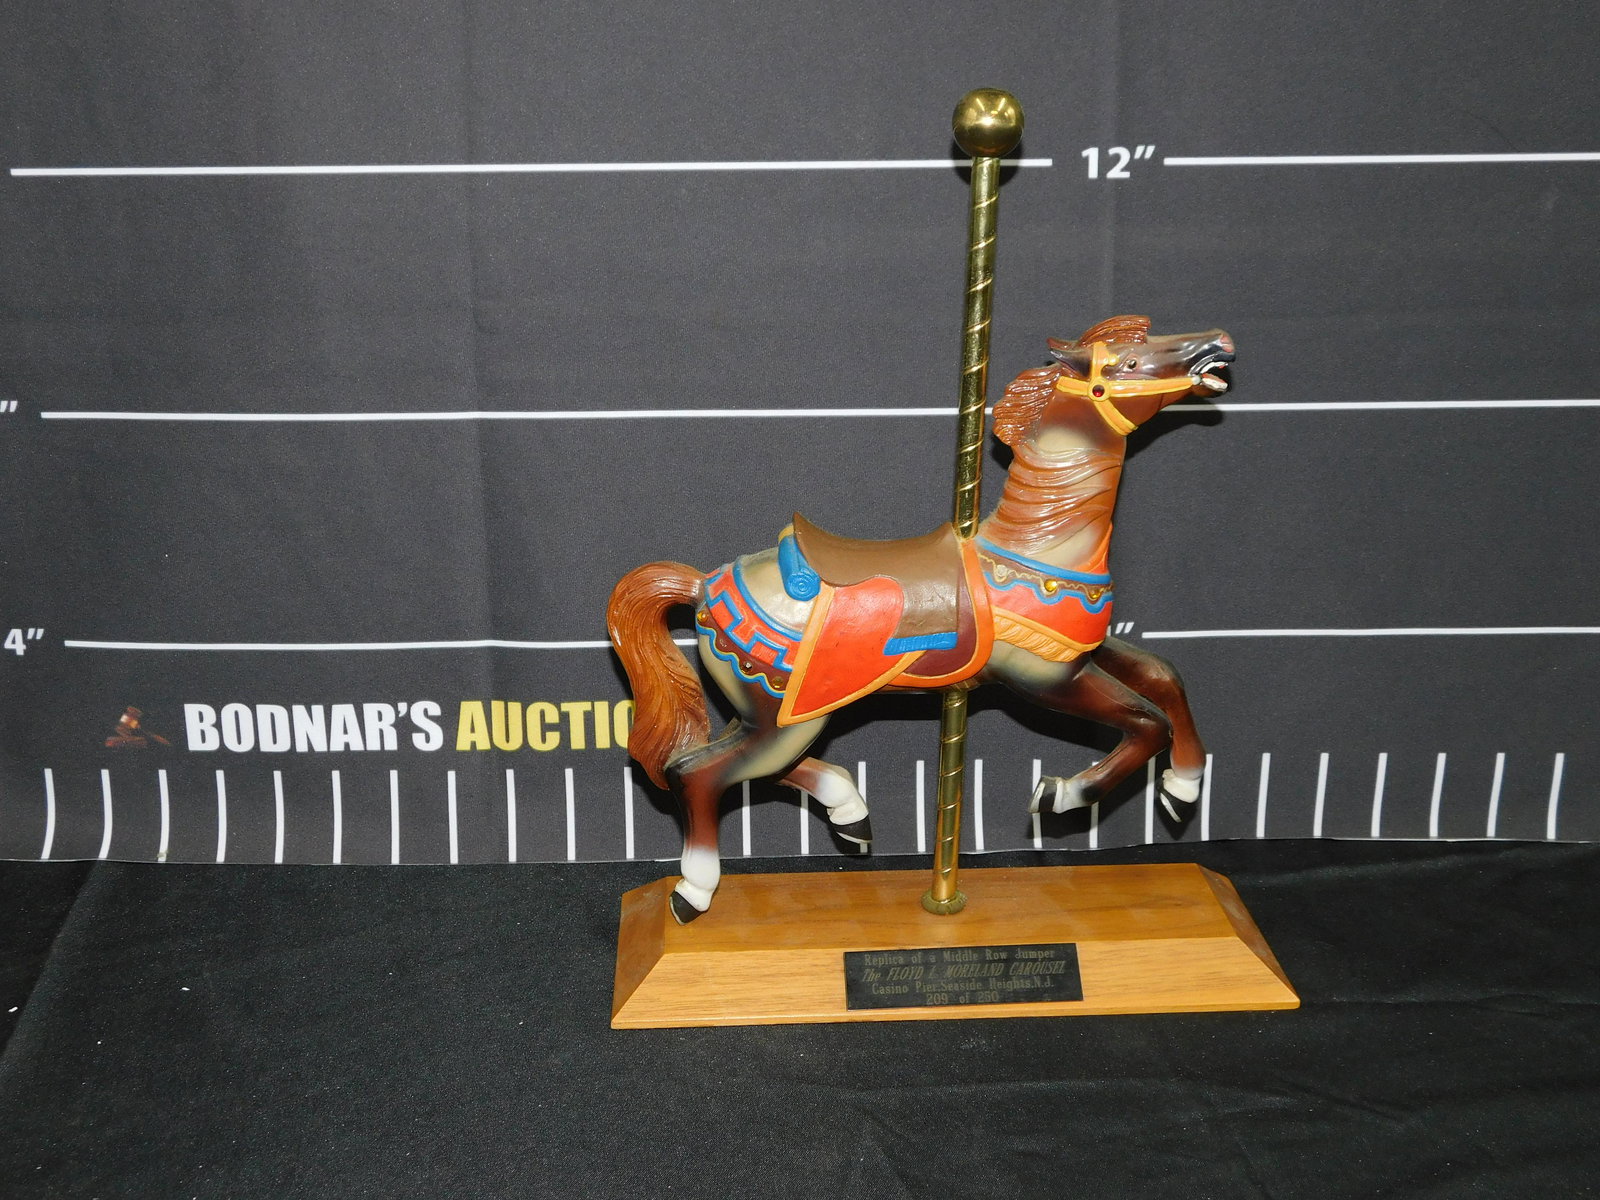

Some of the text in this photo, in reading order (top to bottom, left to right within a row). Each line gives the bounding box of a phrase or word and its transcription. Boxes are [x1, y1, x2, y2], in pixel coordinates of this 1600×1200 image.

[184, 700, 443, 752] BODNAR'S
[864, 947, 1055, 967] Replica of a Middle Row Jumper
[862, 968, 881, 981] The
[886, 966, 924, 981] FLOYD
[943, 962, 1005, 979] MORELAND
[1009, 960, 1066, 976] CAROUSEL
[871, 982, 909, 994] Casino
[926, 993, 948, 1005] 209
[959, 992, 969, 1003] of
